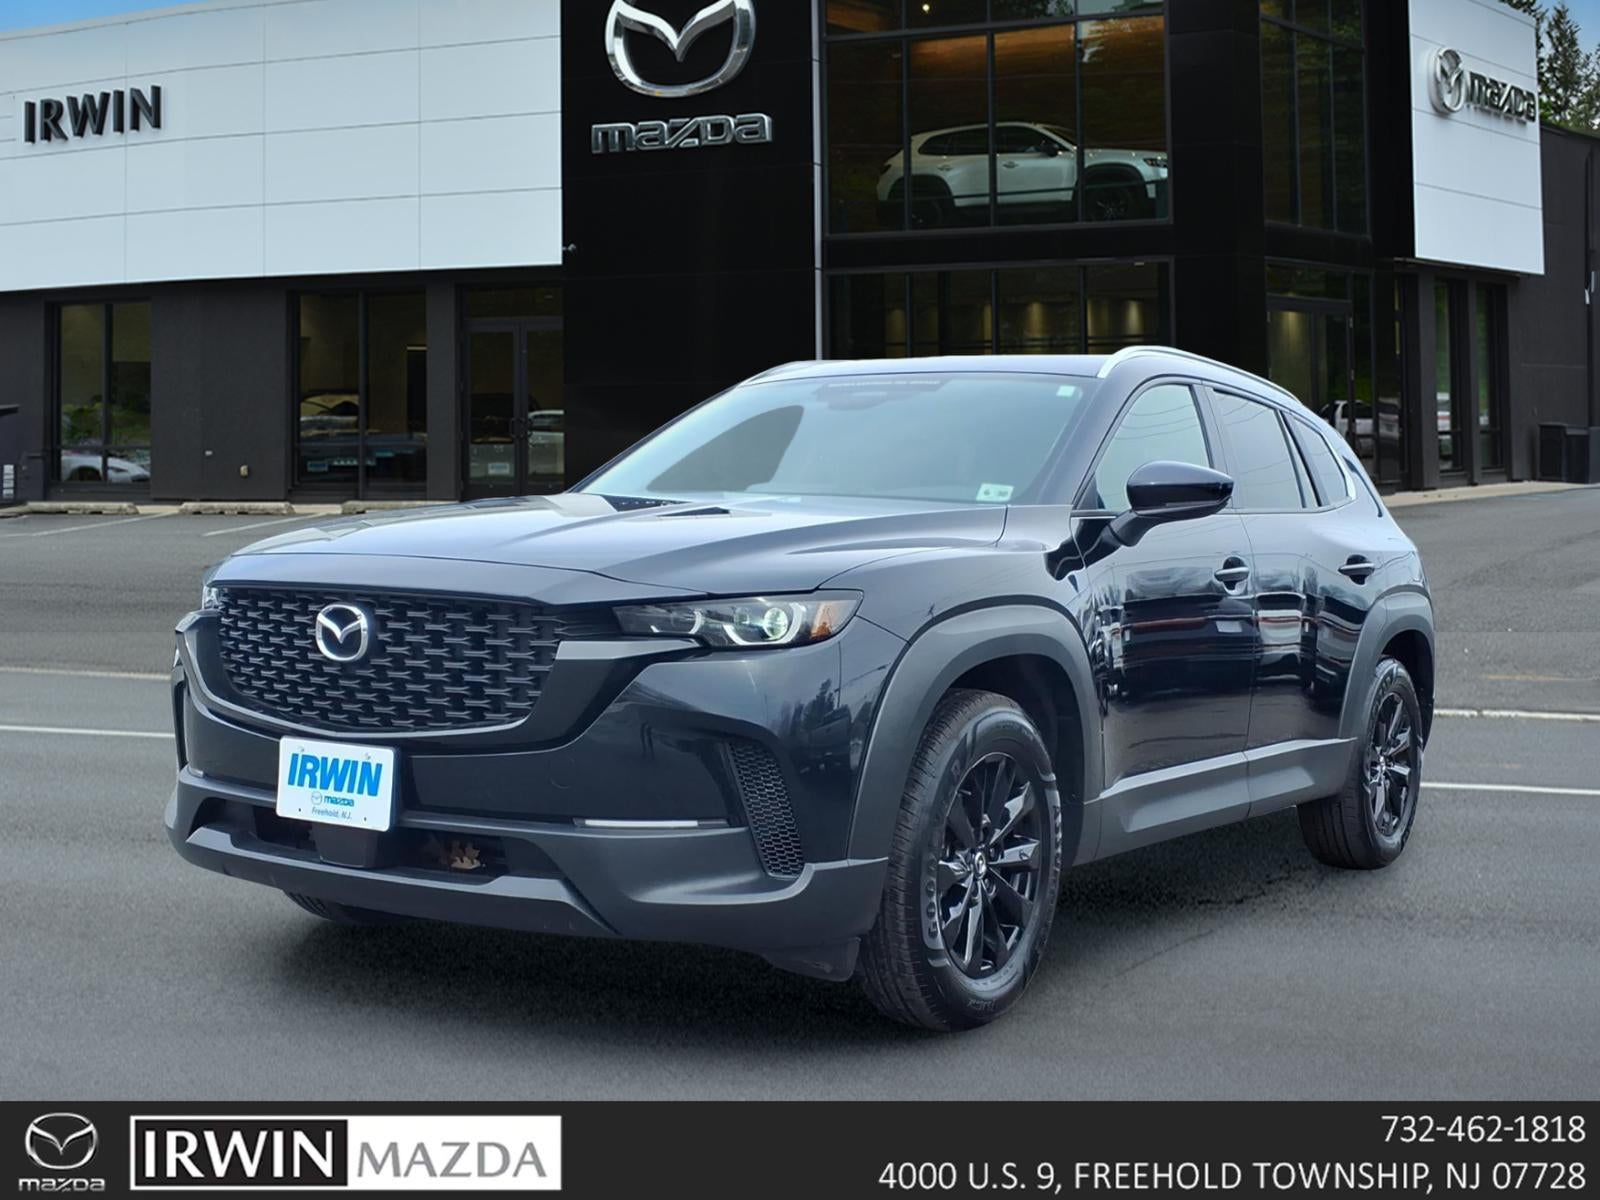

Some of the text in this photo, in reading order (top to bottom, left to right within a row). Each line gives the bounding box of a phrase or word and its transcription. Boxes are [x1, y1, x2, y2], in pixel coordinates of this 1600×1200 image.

[25, 85, 161, 144] IRWIN
[591, 113, 772, 154] mazda
[288, 753, 383, 797] IRWIN
